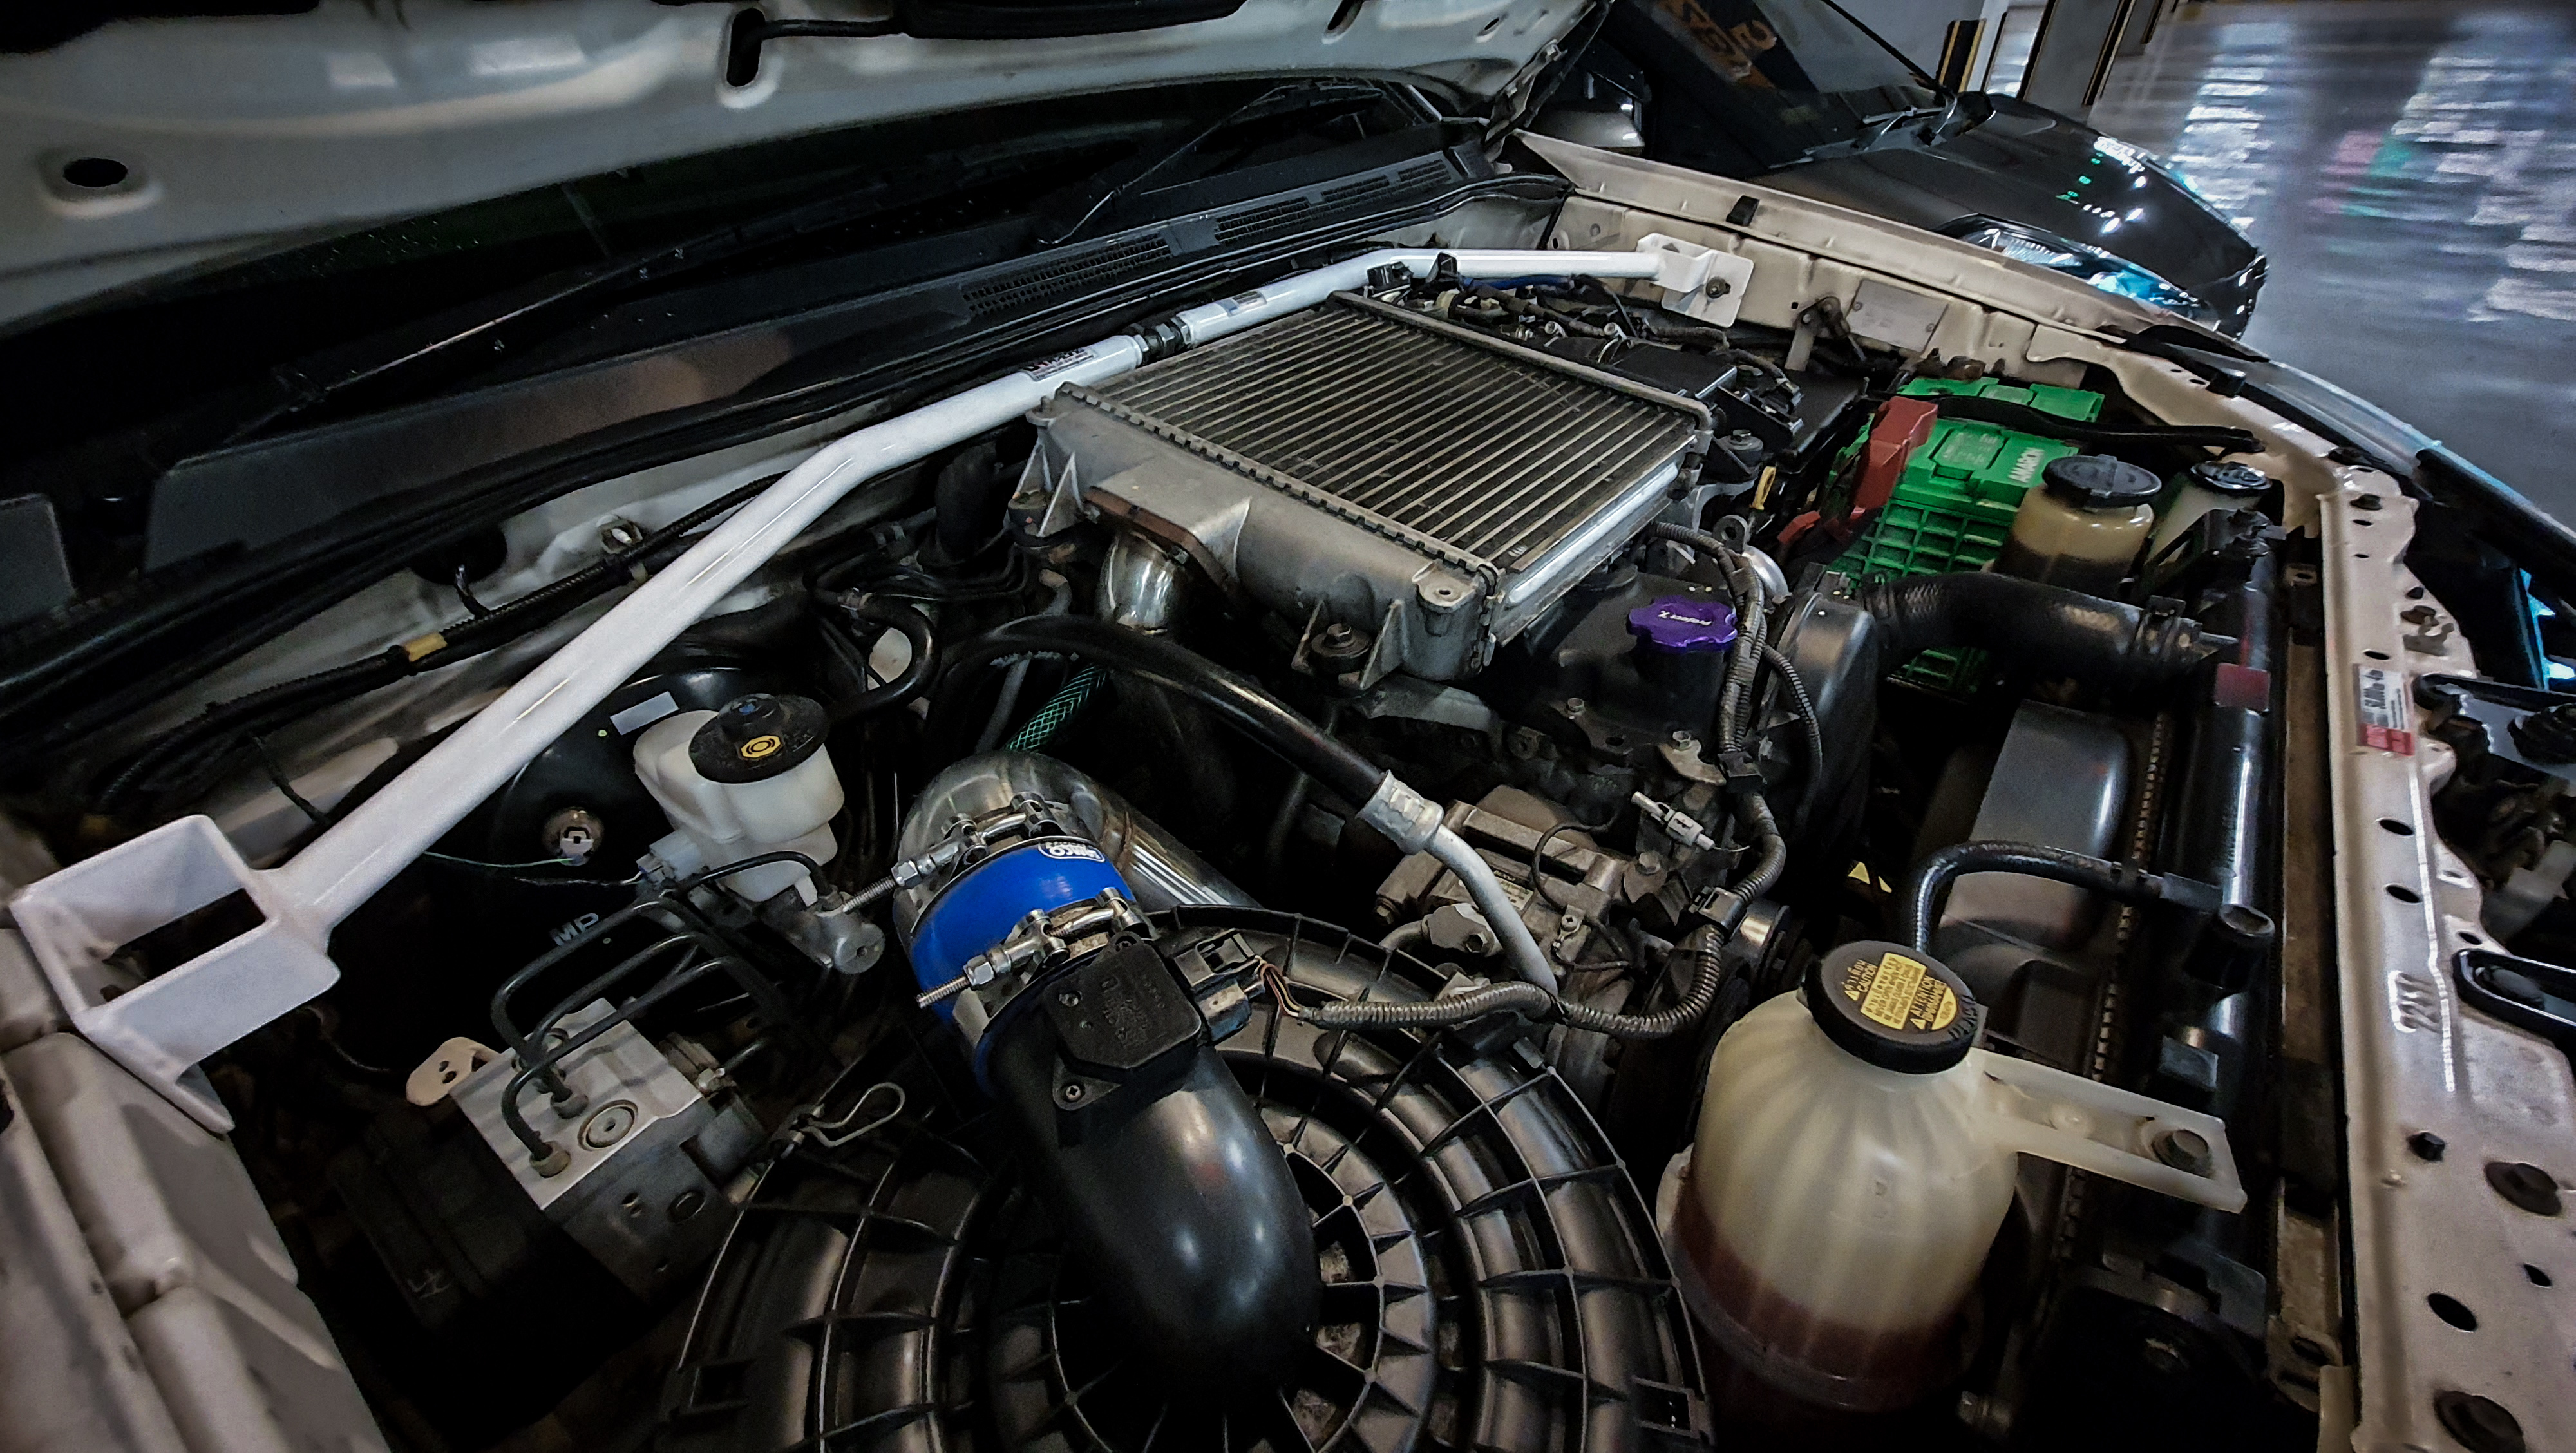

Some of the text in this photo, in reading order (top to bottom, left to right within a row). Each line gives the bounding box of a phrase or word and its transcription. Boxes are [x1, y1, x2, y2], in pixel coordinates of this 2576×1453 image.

[2008, 446, 2045, 483] AMARON
[1857, 963, 1878, 992] CAUTION
[1910, 975, 1935, 1016] ATTENTION
